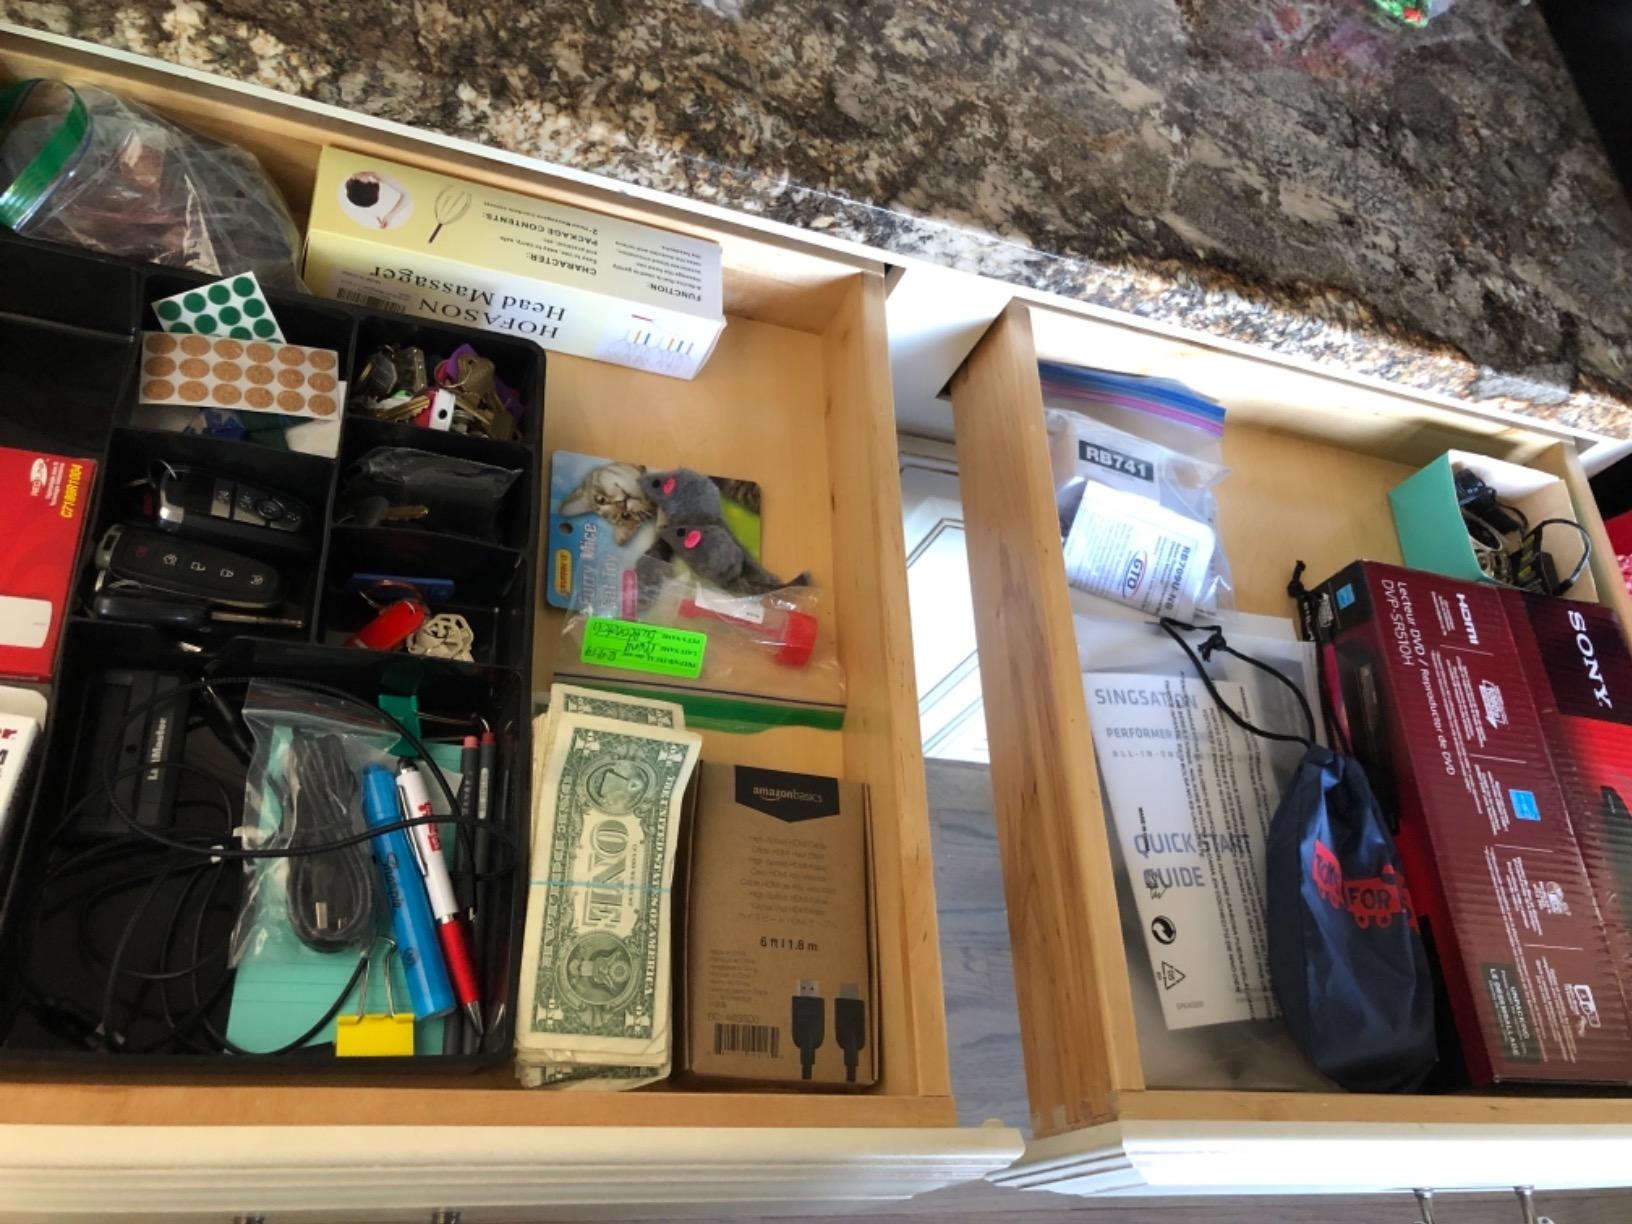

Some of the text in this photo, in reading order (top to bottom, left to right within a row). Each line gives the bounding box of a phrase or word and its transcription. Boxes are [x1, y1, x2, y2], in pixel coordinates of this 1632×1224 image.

[547, 226, 598, 246] PACKAGE
[524, 251, 597, 276] CHARACTER:
[367, 260, 495, 307] Massager
[417, 296, 559, 340] HOFASON
[501, 293, 566, 321] Head
[1084, 445, 1148, 477] RB741
[579, 522, 597, 560] Mice
[1125, 557, 1144, 590] GTO
[1380, 577, 1414, 668] DVP-SR510H
[1455, 592, 1479, 646] HDMI
[1564, 606, 1615, 712] SONY
[1396, 580, 1456, 776] Lecteur DVD / Reproductor de DVD
[1105, 727, 1173, 739] PERFORMER
[752, 785, 823, 803] amazonbasics
[1132, 832, 1197, 856] QUICK
[581, 816, 632, 929] ONE
[1142, 867, 1206, 887] GUIDE
[1345, 887, 1391, 909] FOR
[759, 936, 767, 947] 6
[787, 939, 804, 950] 1.8
[807, 941, 818, 951] m
[642, 928, 658, 997] AMERICA
